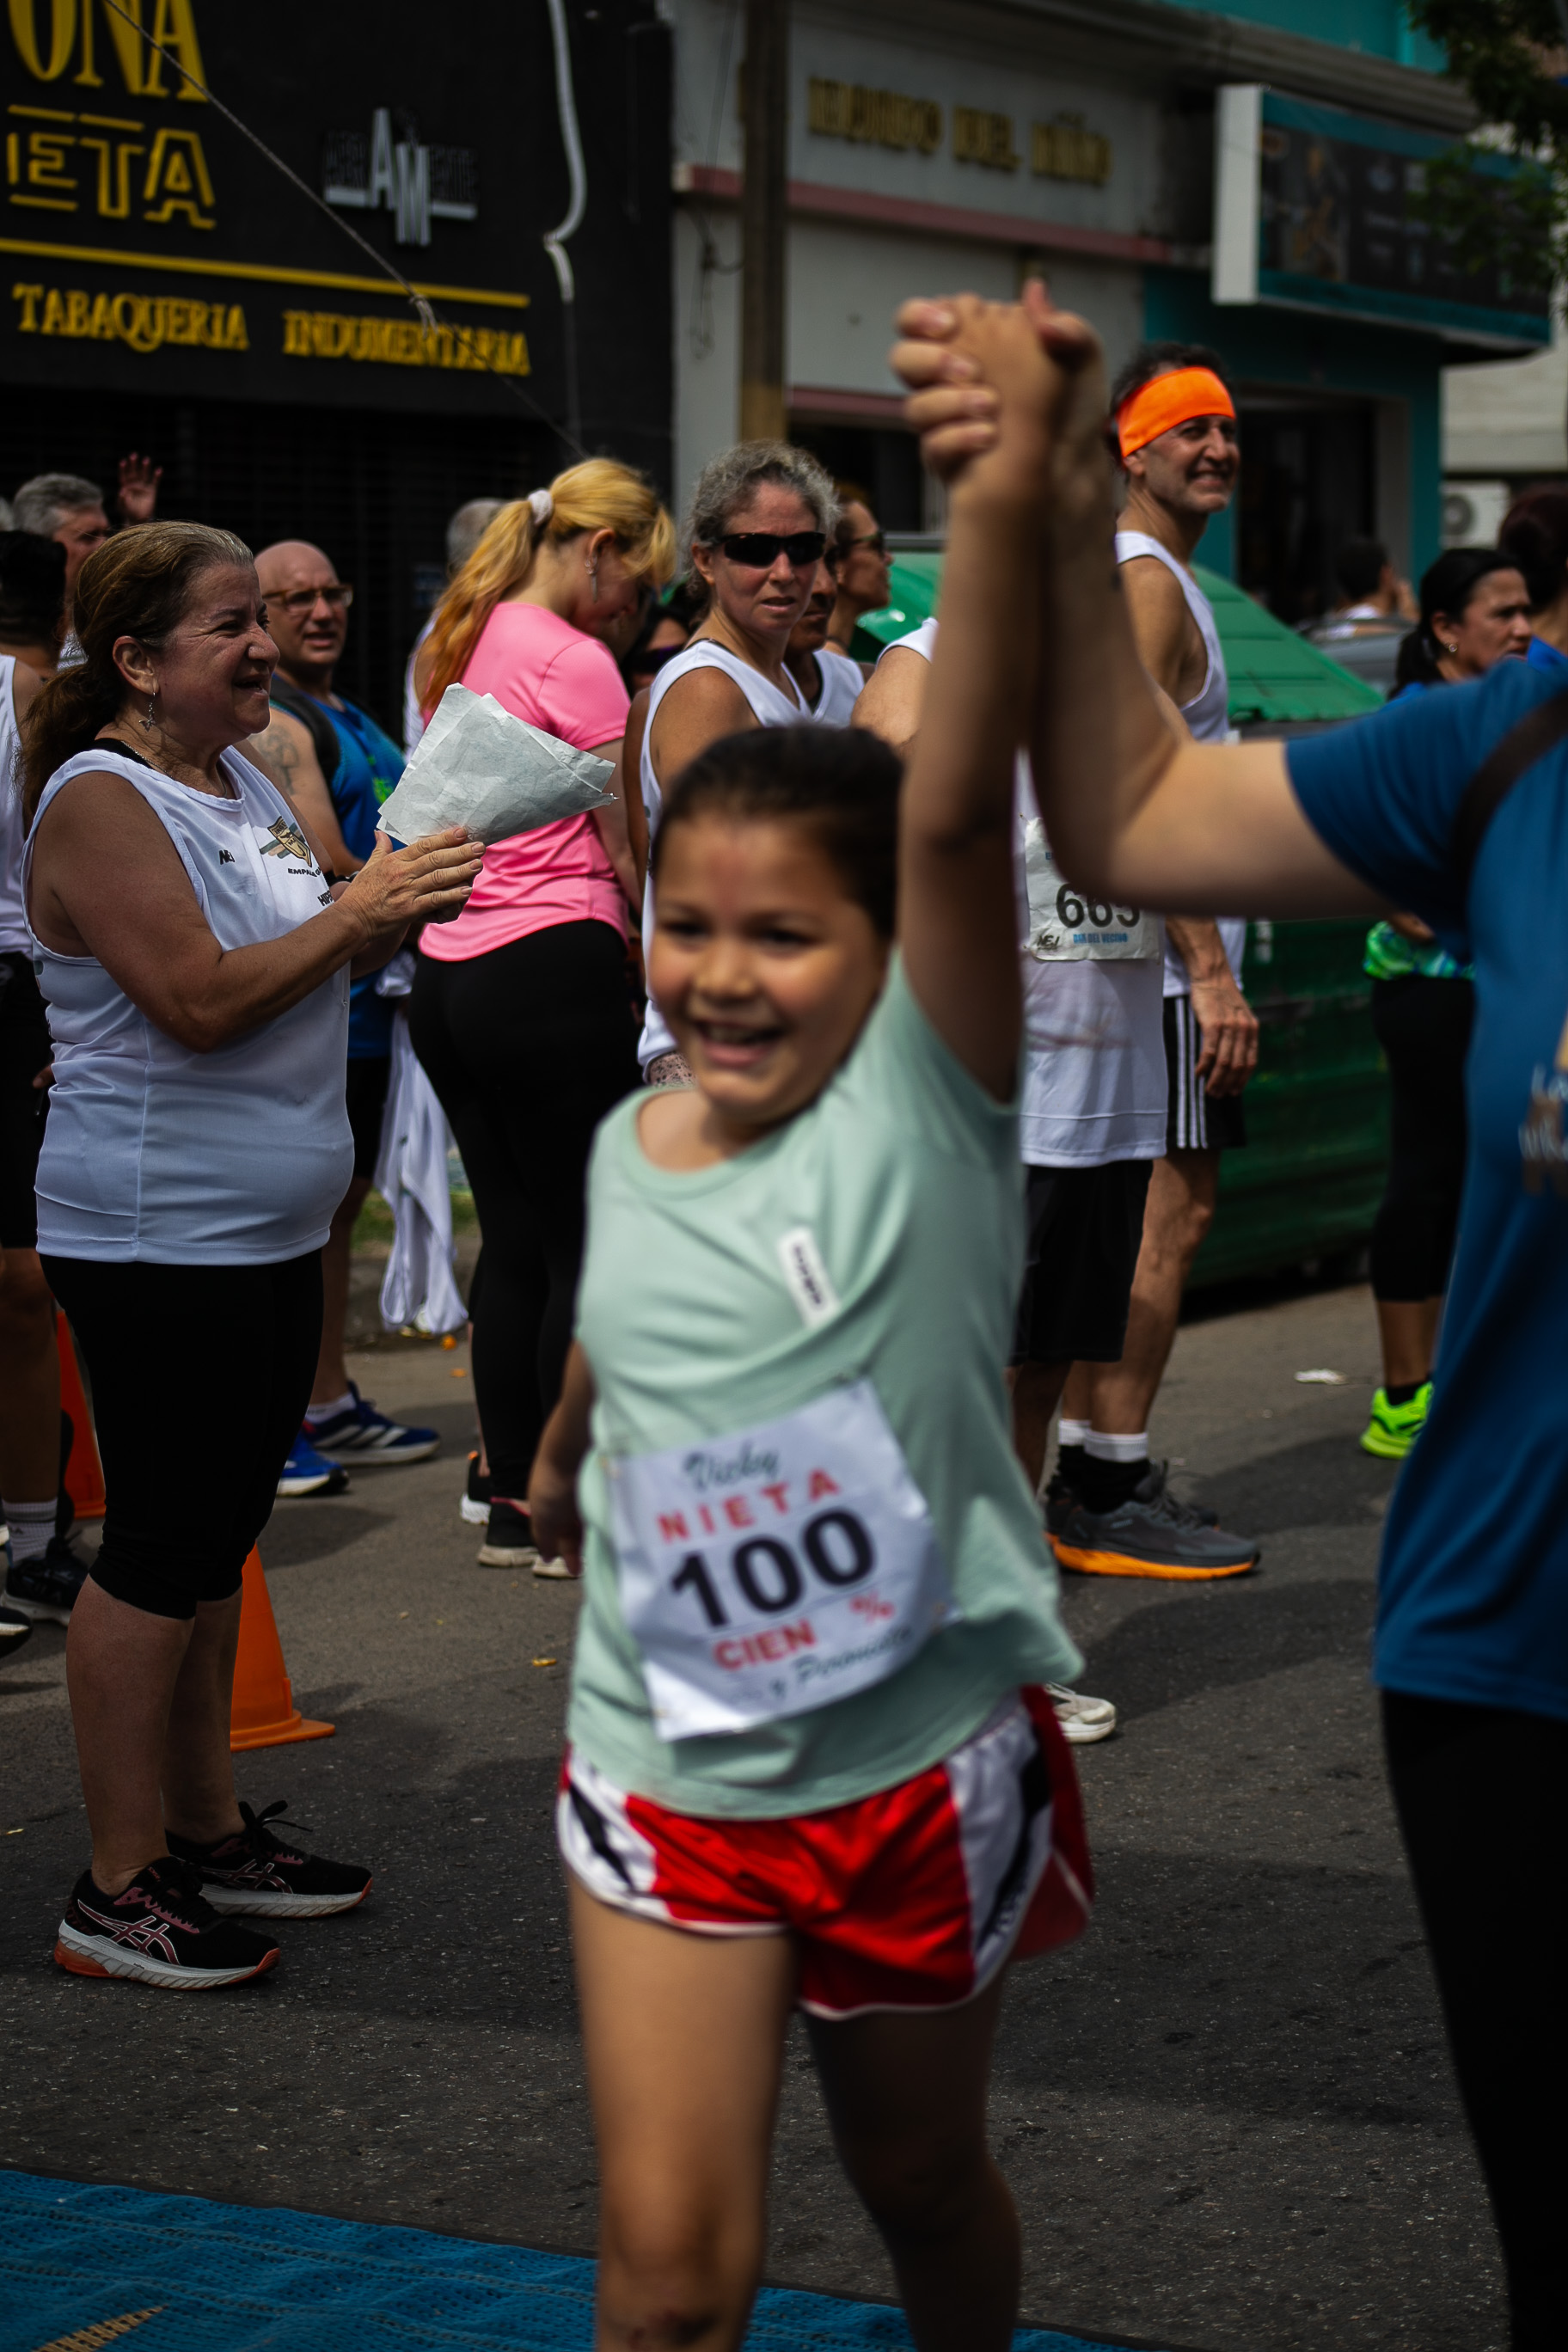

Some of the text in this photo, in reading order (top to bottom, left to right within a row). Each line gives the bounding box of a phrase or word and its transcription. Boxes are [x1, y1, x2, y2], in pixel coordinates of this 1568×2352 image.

[13, 283, 531, 376] TABAQUERIA INDUMENTARIA
[656, 1467, 840, 1545] NIETA
[670, 1506, 876, 1628] 100
[713, 1618, 818, 1670] CIEN
